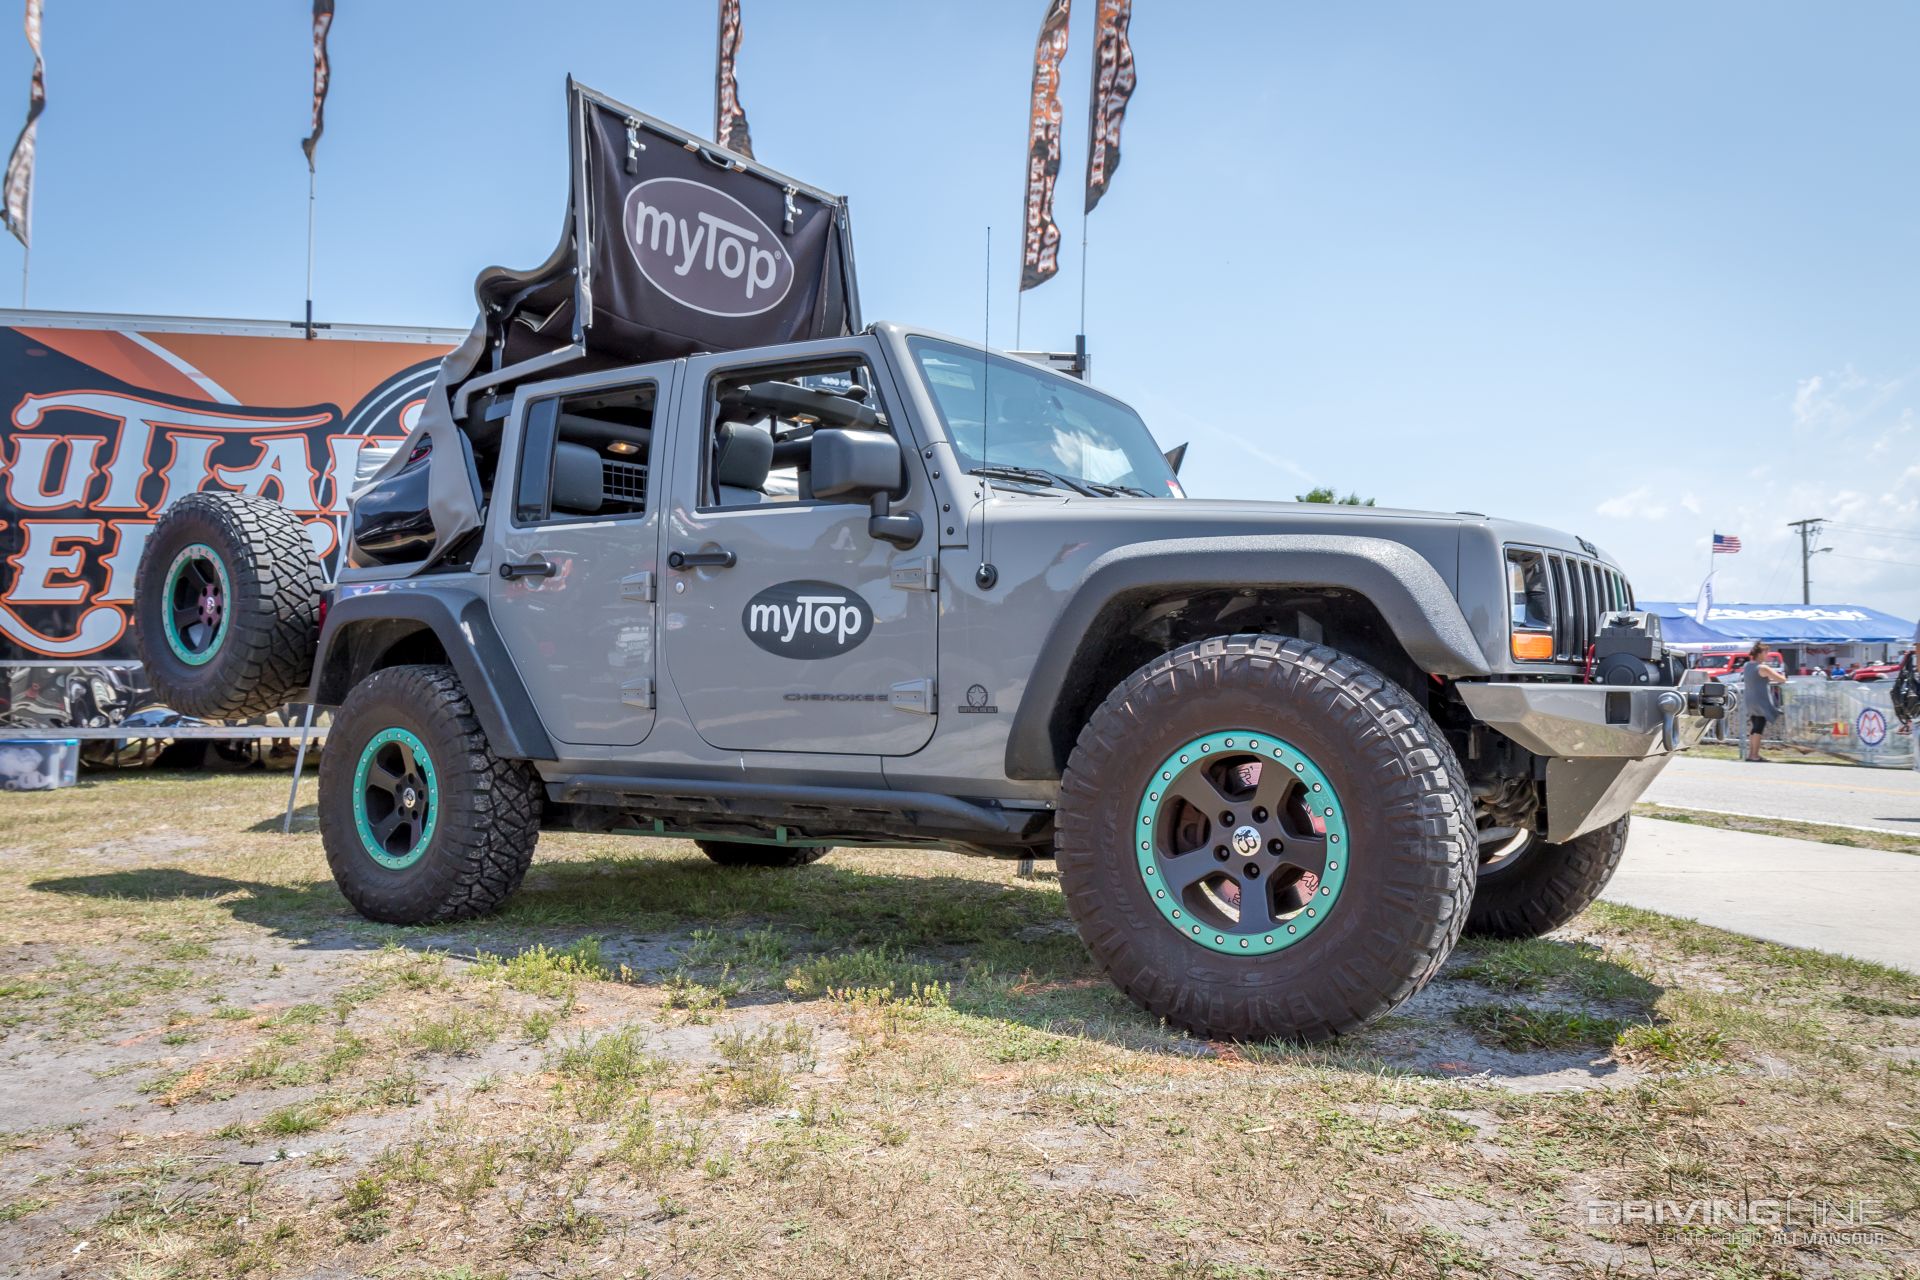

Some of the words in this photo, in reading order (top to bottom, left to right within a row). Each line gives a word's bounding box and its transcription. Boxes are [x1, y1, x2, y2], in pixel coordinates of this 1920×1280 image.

[1025, 157, 1045, 265] LIGHT
[0, 389, 408, 517] UTLA
[750, 595, 862, 645] myTop
[783, 693, 889, 702] CHEROKEE
